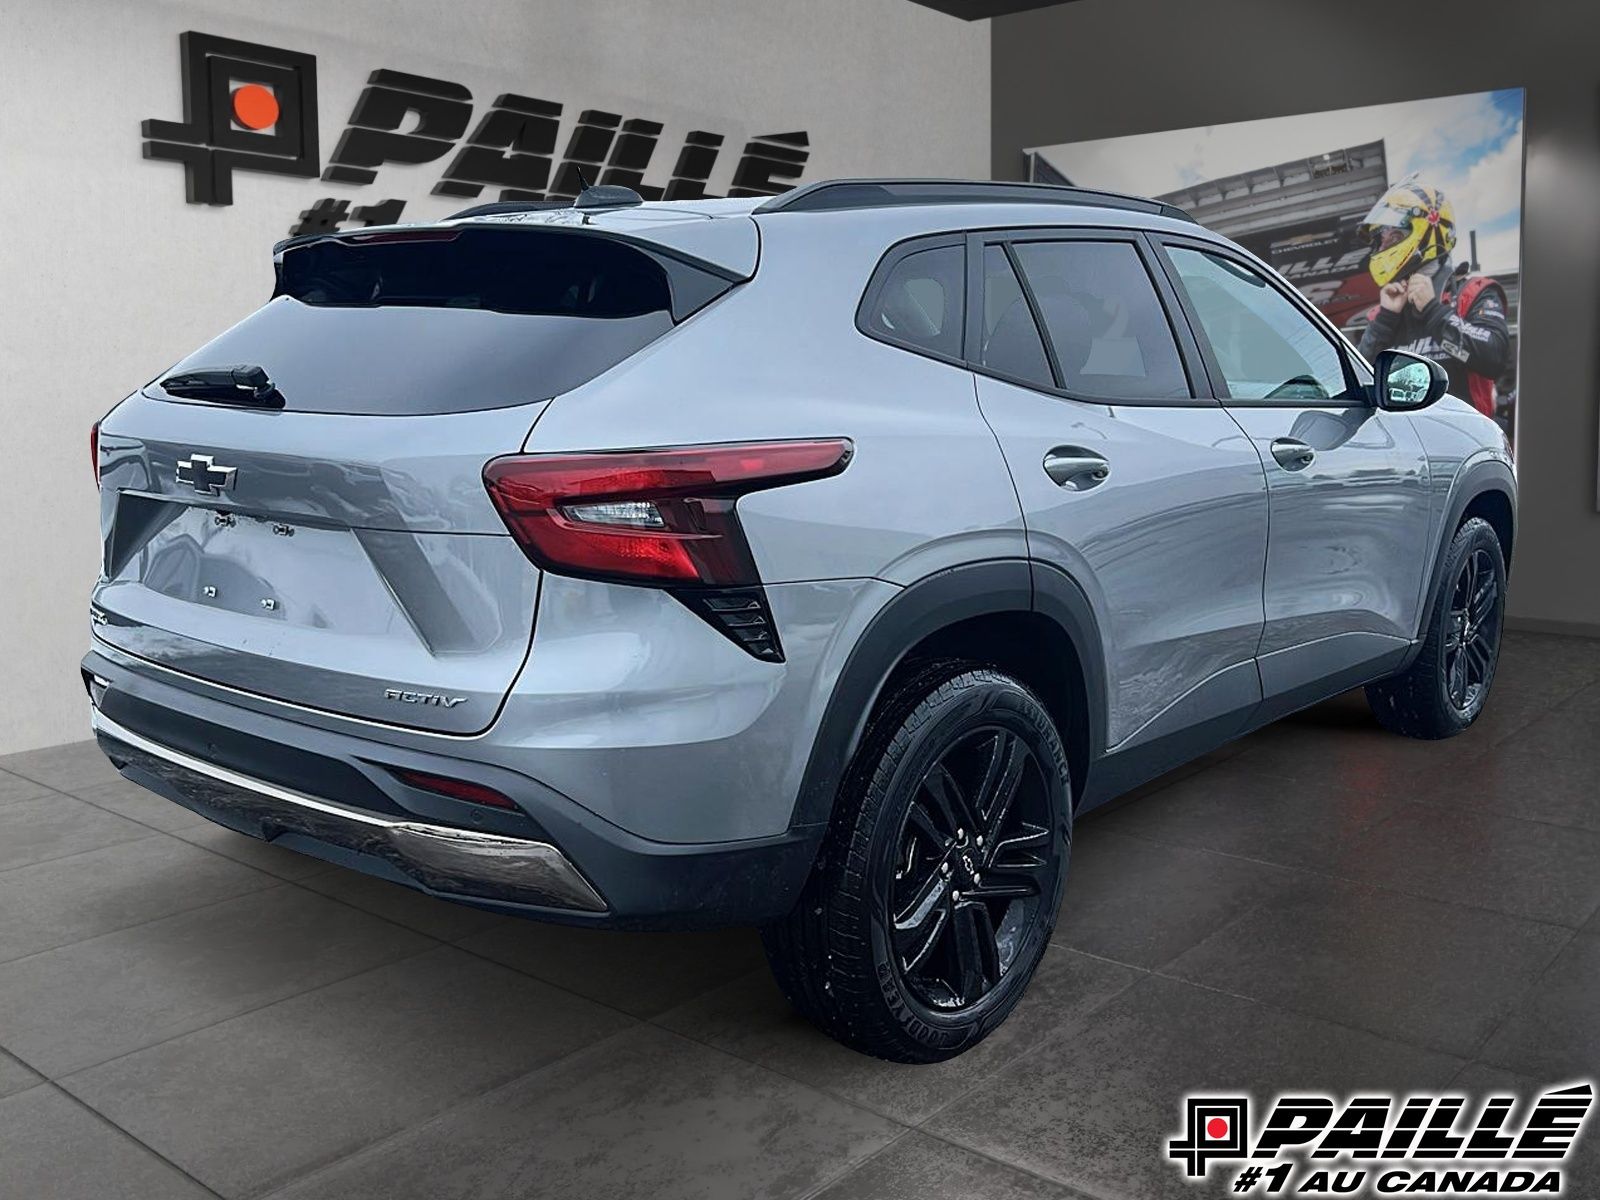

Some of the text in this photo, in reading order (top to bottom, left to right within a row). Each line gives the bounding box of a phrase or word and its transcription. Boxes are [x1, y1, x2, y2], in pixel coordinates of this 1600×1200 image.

[320, 69, 809, 200] PAILLÉ
[289, 198, 408, 236] #1
[1271, 237, 1340, 255] CHEVROLET
[384, 688, 469, 708] ACTIV
